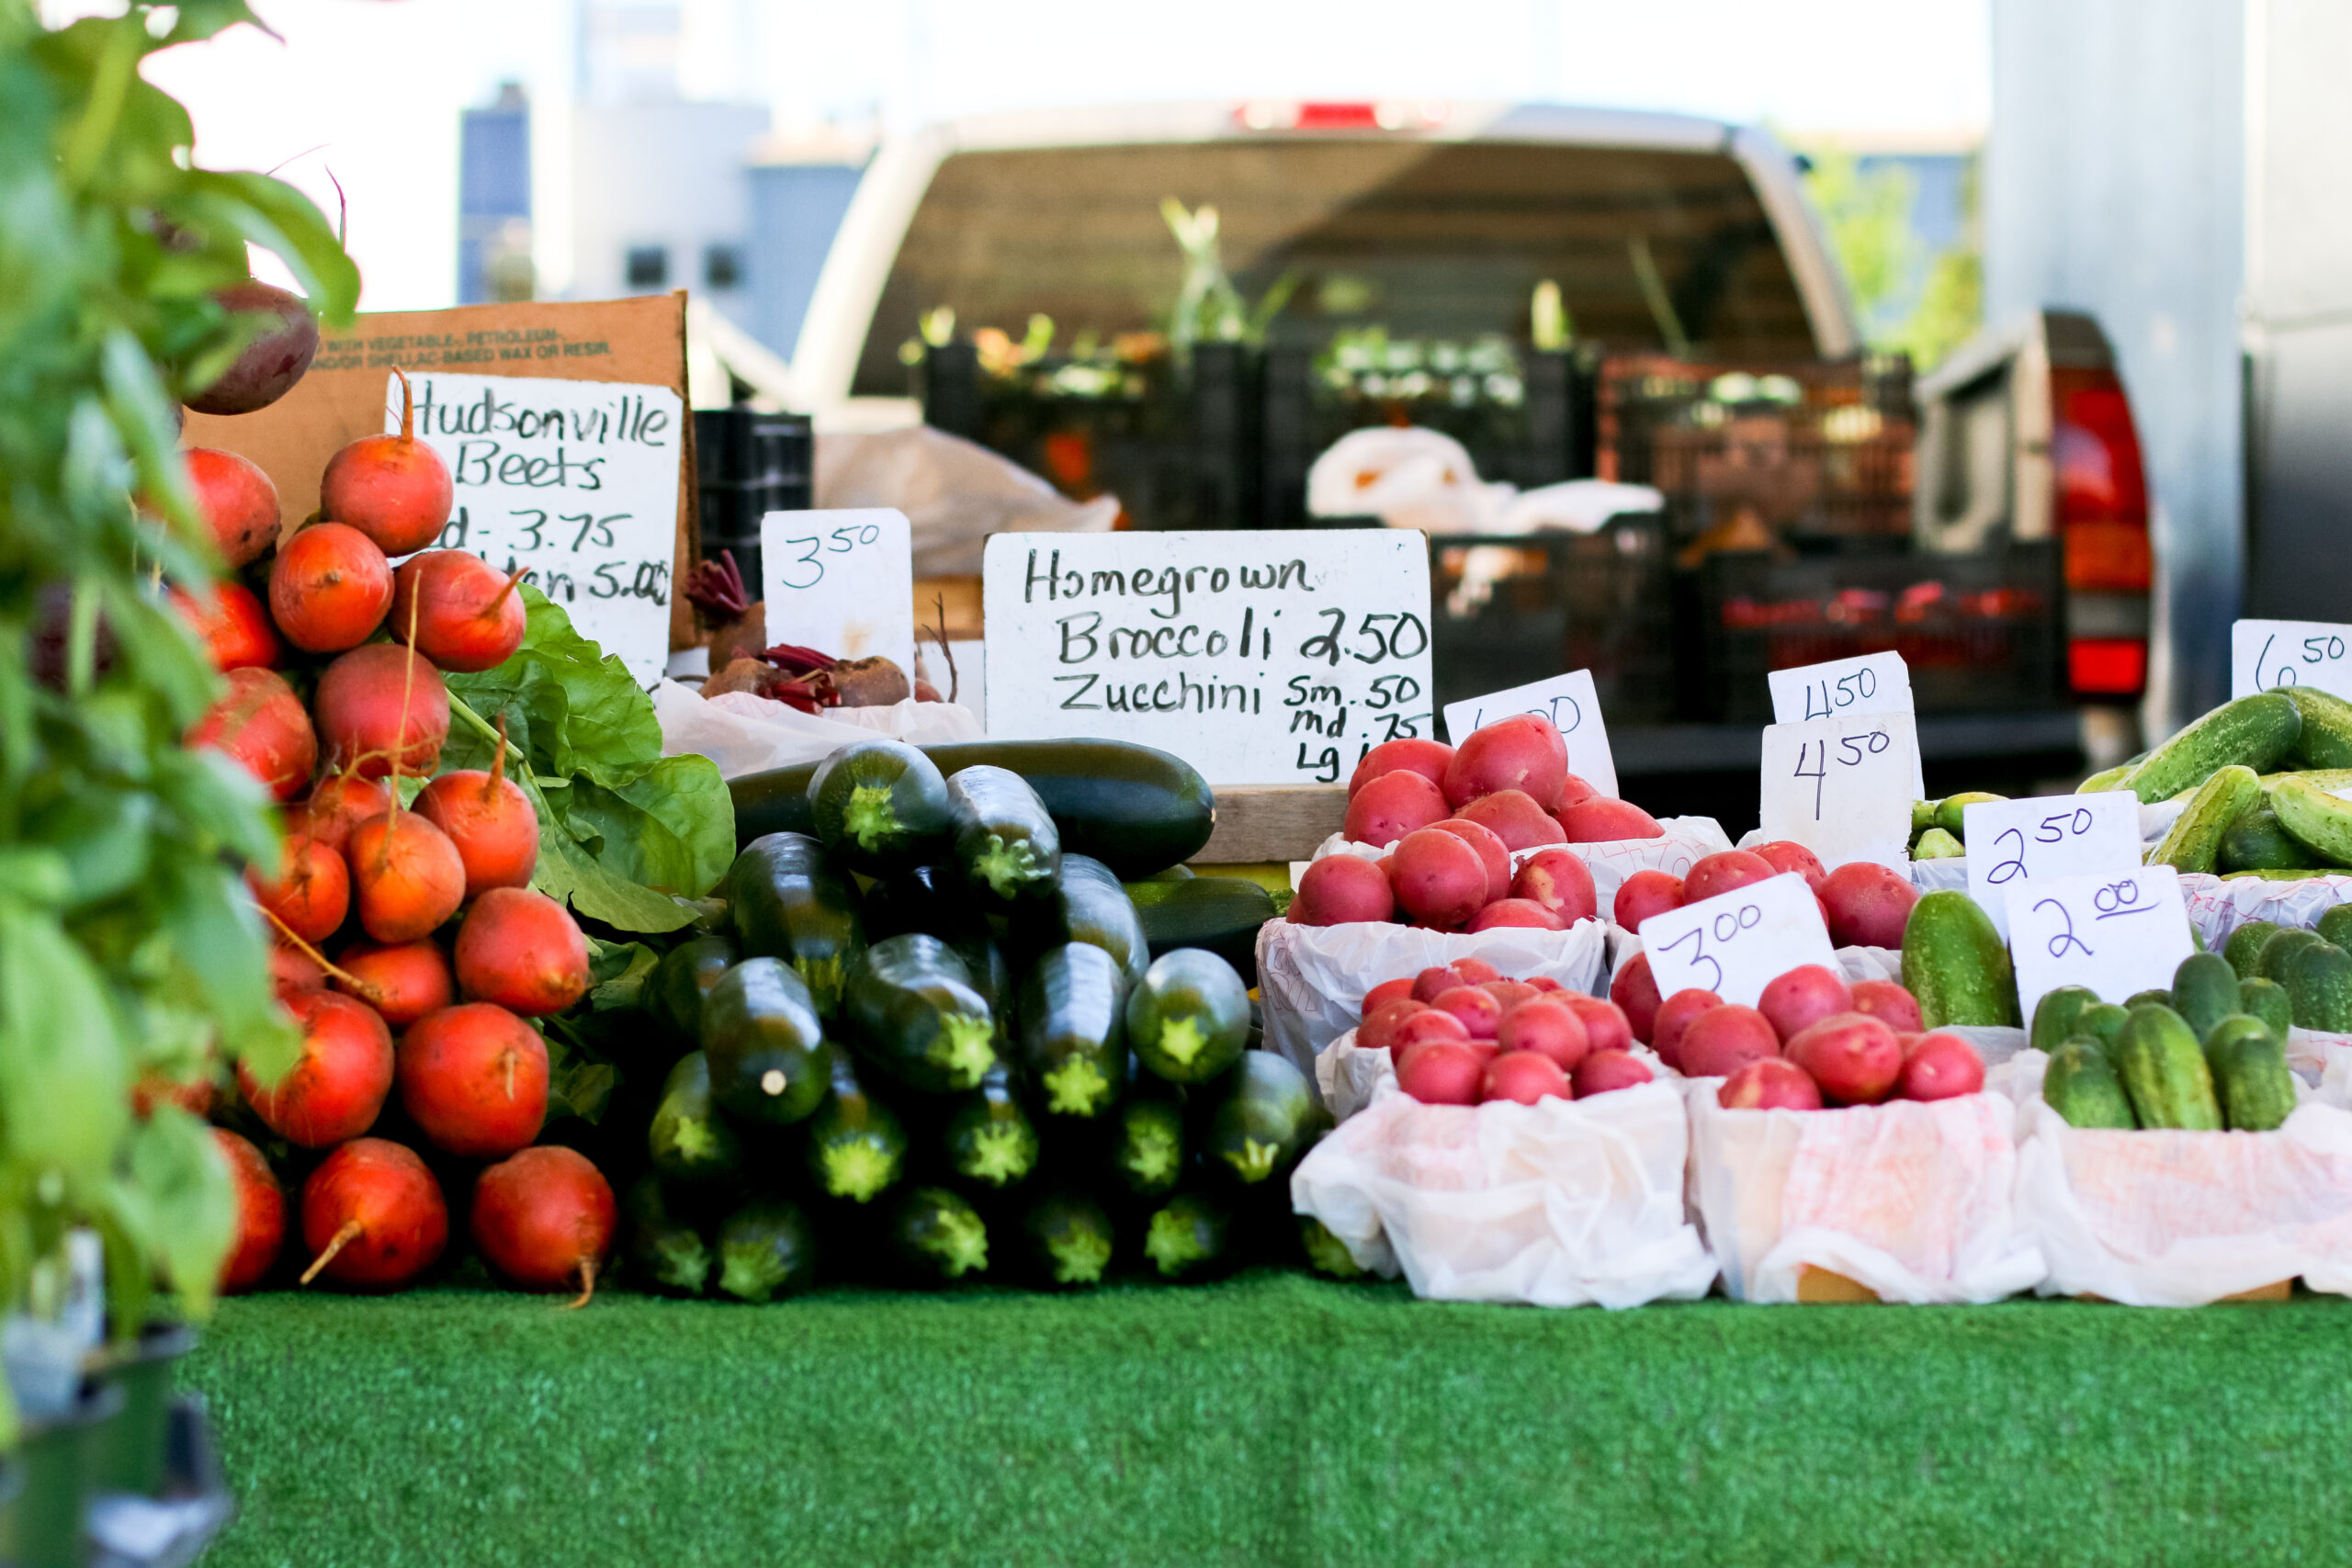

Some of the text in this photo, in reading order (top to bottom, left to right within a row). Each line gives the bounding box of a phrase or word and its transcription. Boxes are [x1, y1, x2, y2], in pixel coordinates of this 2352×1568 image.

[499, 346, 532, 361] WAX
[537, 343, 560, 359] OR
[402, 378, 669, 446] Hudsonville
[456, 440, 605, 491] Beets
[508, 509, 633, 552] 3.75
[1024, 548, 1315, 618] Homegrown
[1055, 606, 1429, 667] Broccoli 2.50
[1053, 671, 1265, 715] Zucchini
[1296, 742, 1340, 783] Lg
